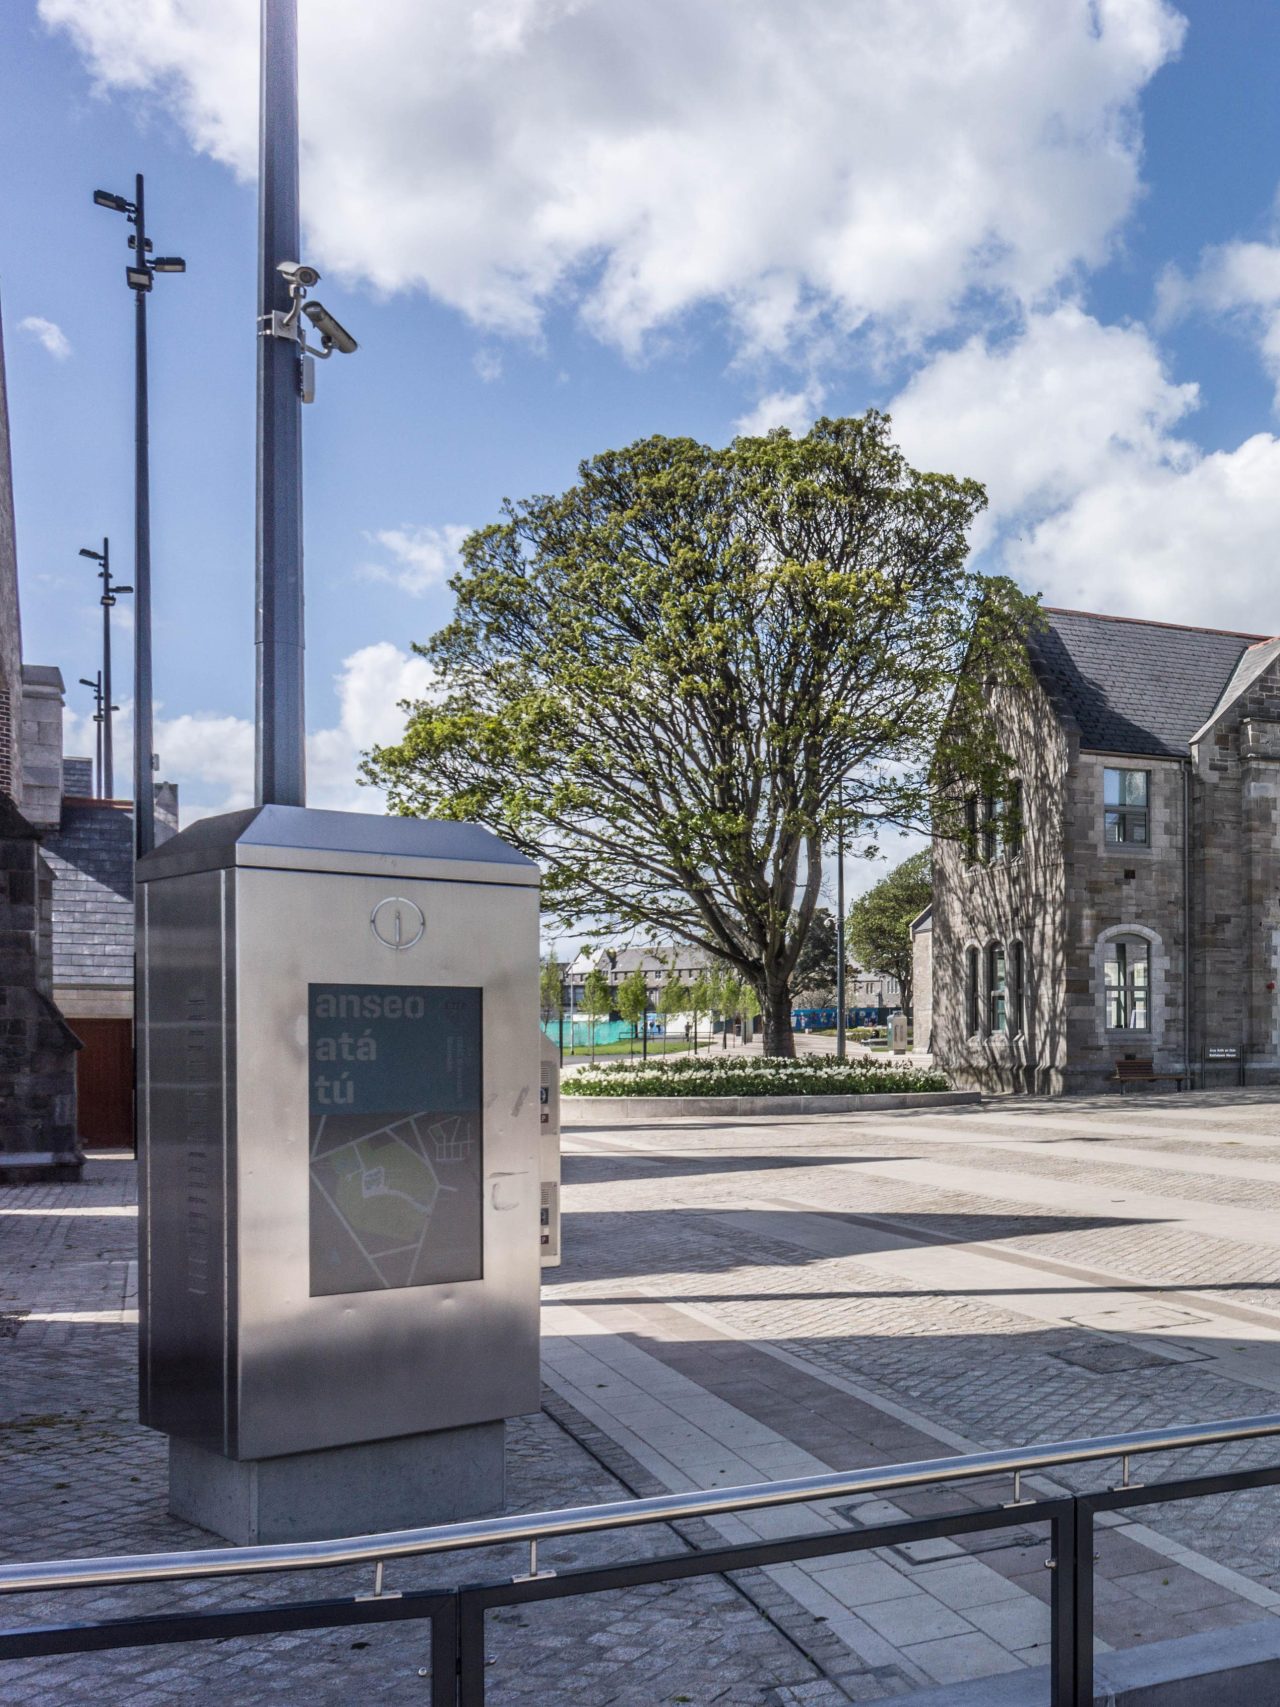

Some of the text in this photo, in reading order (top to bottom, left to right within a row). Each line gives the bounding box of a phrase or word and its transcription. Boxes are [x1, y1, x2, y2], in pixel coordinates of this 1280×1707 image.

[315, 993, 424, 1019] anseo
[315, 1029, 377, 1061] atá
[315, 1071, 354, 1104] tú
